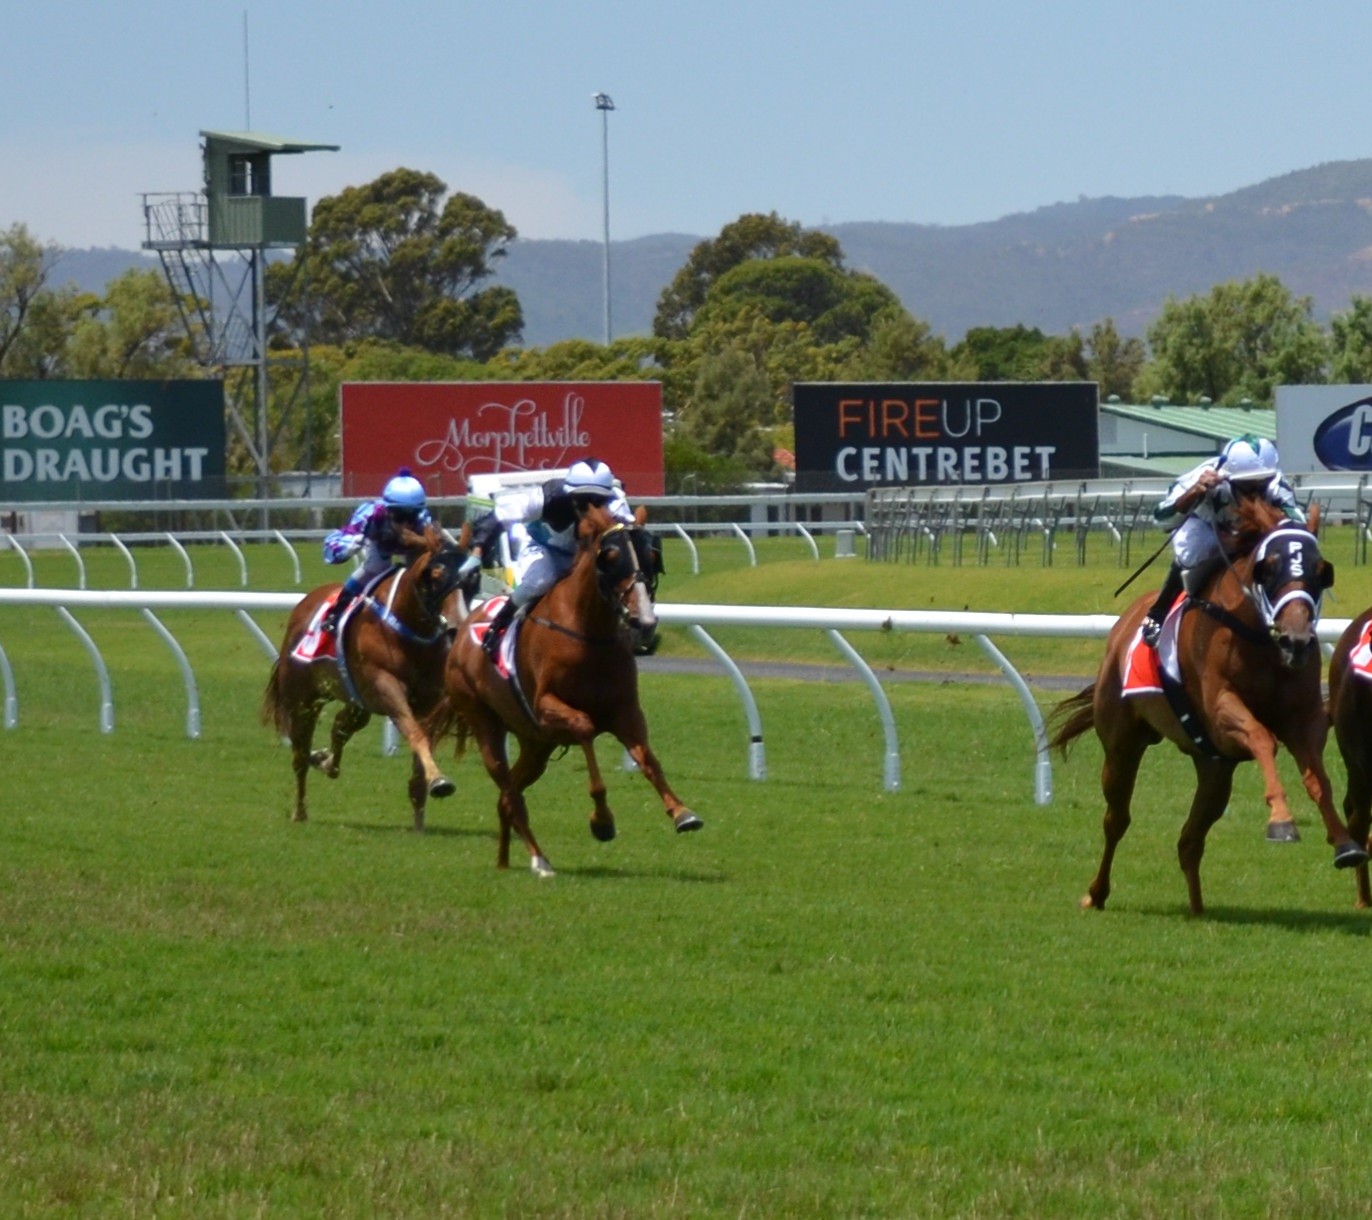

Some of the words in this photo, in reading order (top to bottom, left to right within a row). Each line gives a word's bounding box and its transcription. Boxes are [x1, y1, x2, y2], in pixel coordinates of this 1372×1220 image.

[2, 404, 154, 439] BOAG'S
[415, 391, 592, 475] Morphettville
[3, 447, 209, 482] DRAUGHT
[836, 446, 1056, 482] CENTREBET
